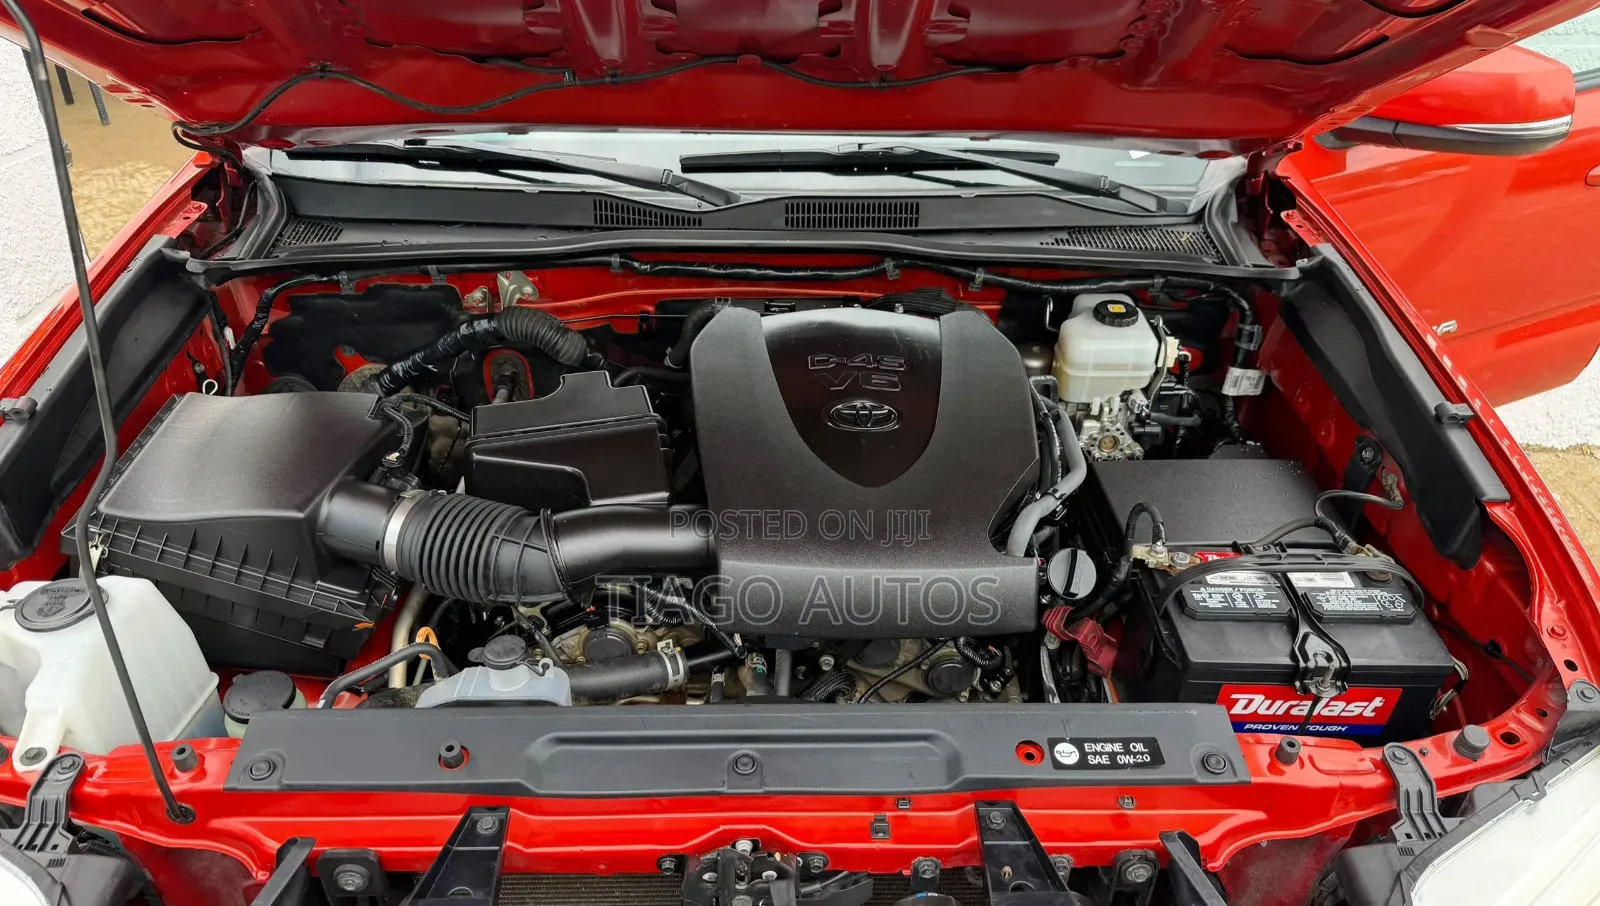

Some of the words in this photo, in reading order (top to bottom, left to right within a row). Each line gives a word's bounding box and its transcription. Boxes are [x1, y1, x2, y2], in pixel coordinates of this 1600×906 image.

[808, 354, 906, 371] D-4S
[815, 372, 902, 391] V6
[1229, 694, 1385, 717] Duralast
[1244, 723, 1300, 731] PROVEN
[1084, 742, 1123, 752] ENGINE
[1130, 743, 1148, 752] OIL
[1088, 754, 1110, 764] SAE
[1117, 754, 1150, 764] 0W-20
